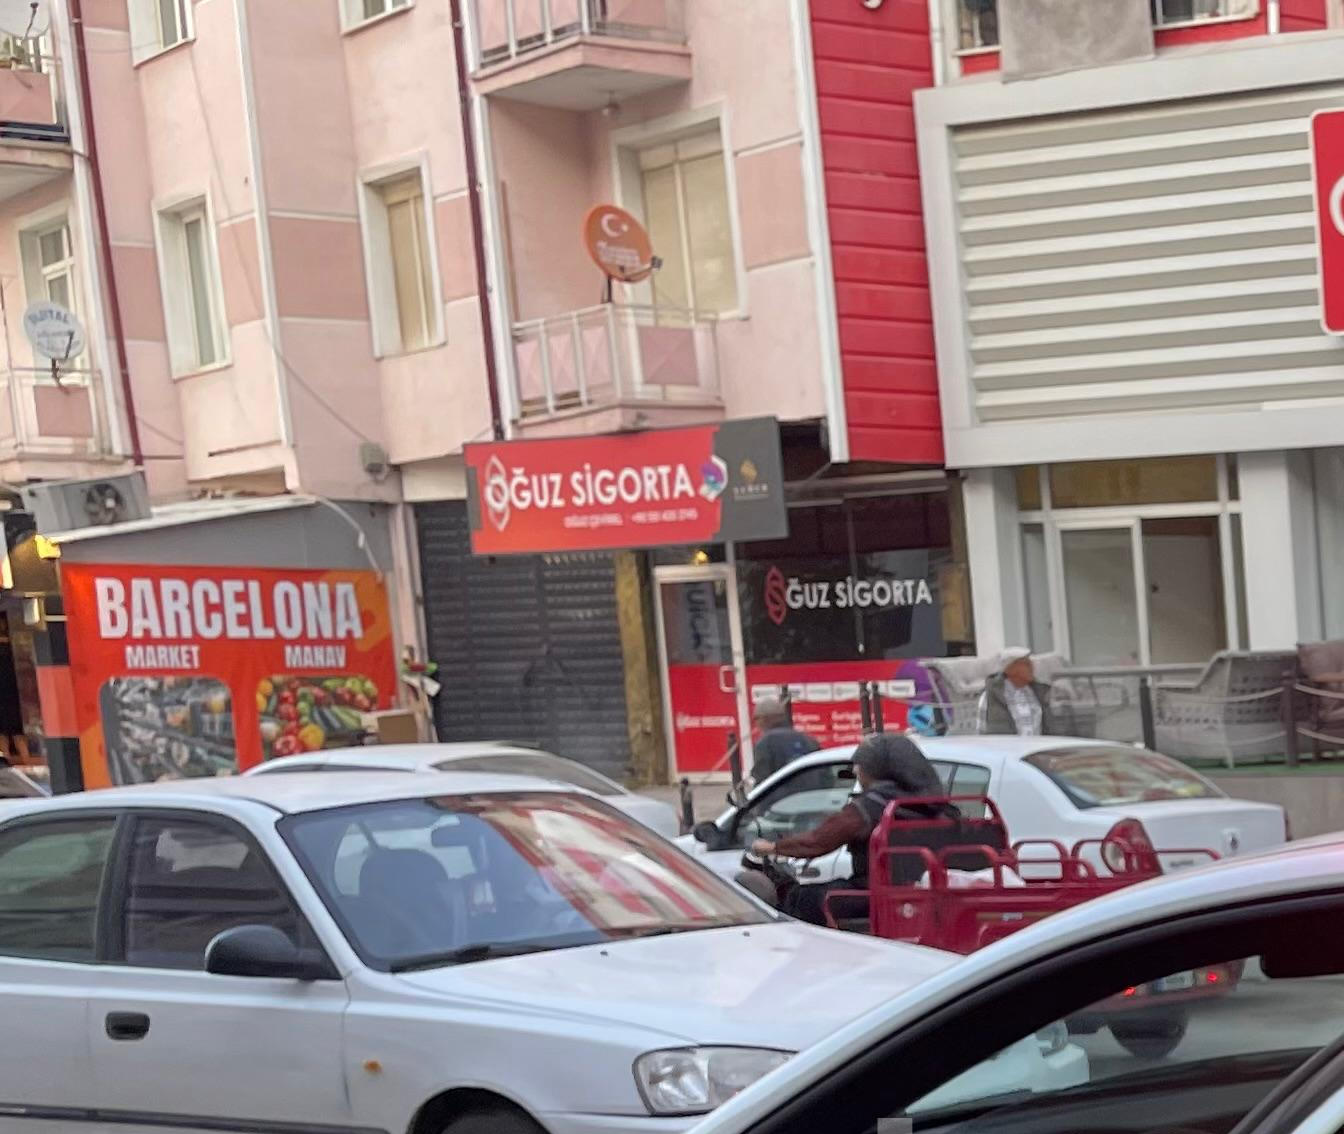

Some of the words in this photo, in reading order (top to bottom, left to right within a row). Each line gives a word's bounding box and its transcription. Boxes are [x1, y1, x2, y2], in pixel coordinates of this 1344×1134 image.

[485, 467, 565, 512] OĞUZ
[570, 463, 695, 506] SİGORTA
[95, 577, 364, 639] BARCELONA
[835, 576, 933, 607] SİGORTA
[125, 645, 201, 669] MARKET
[284, 645, 346, 668] MANAV
